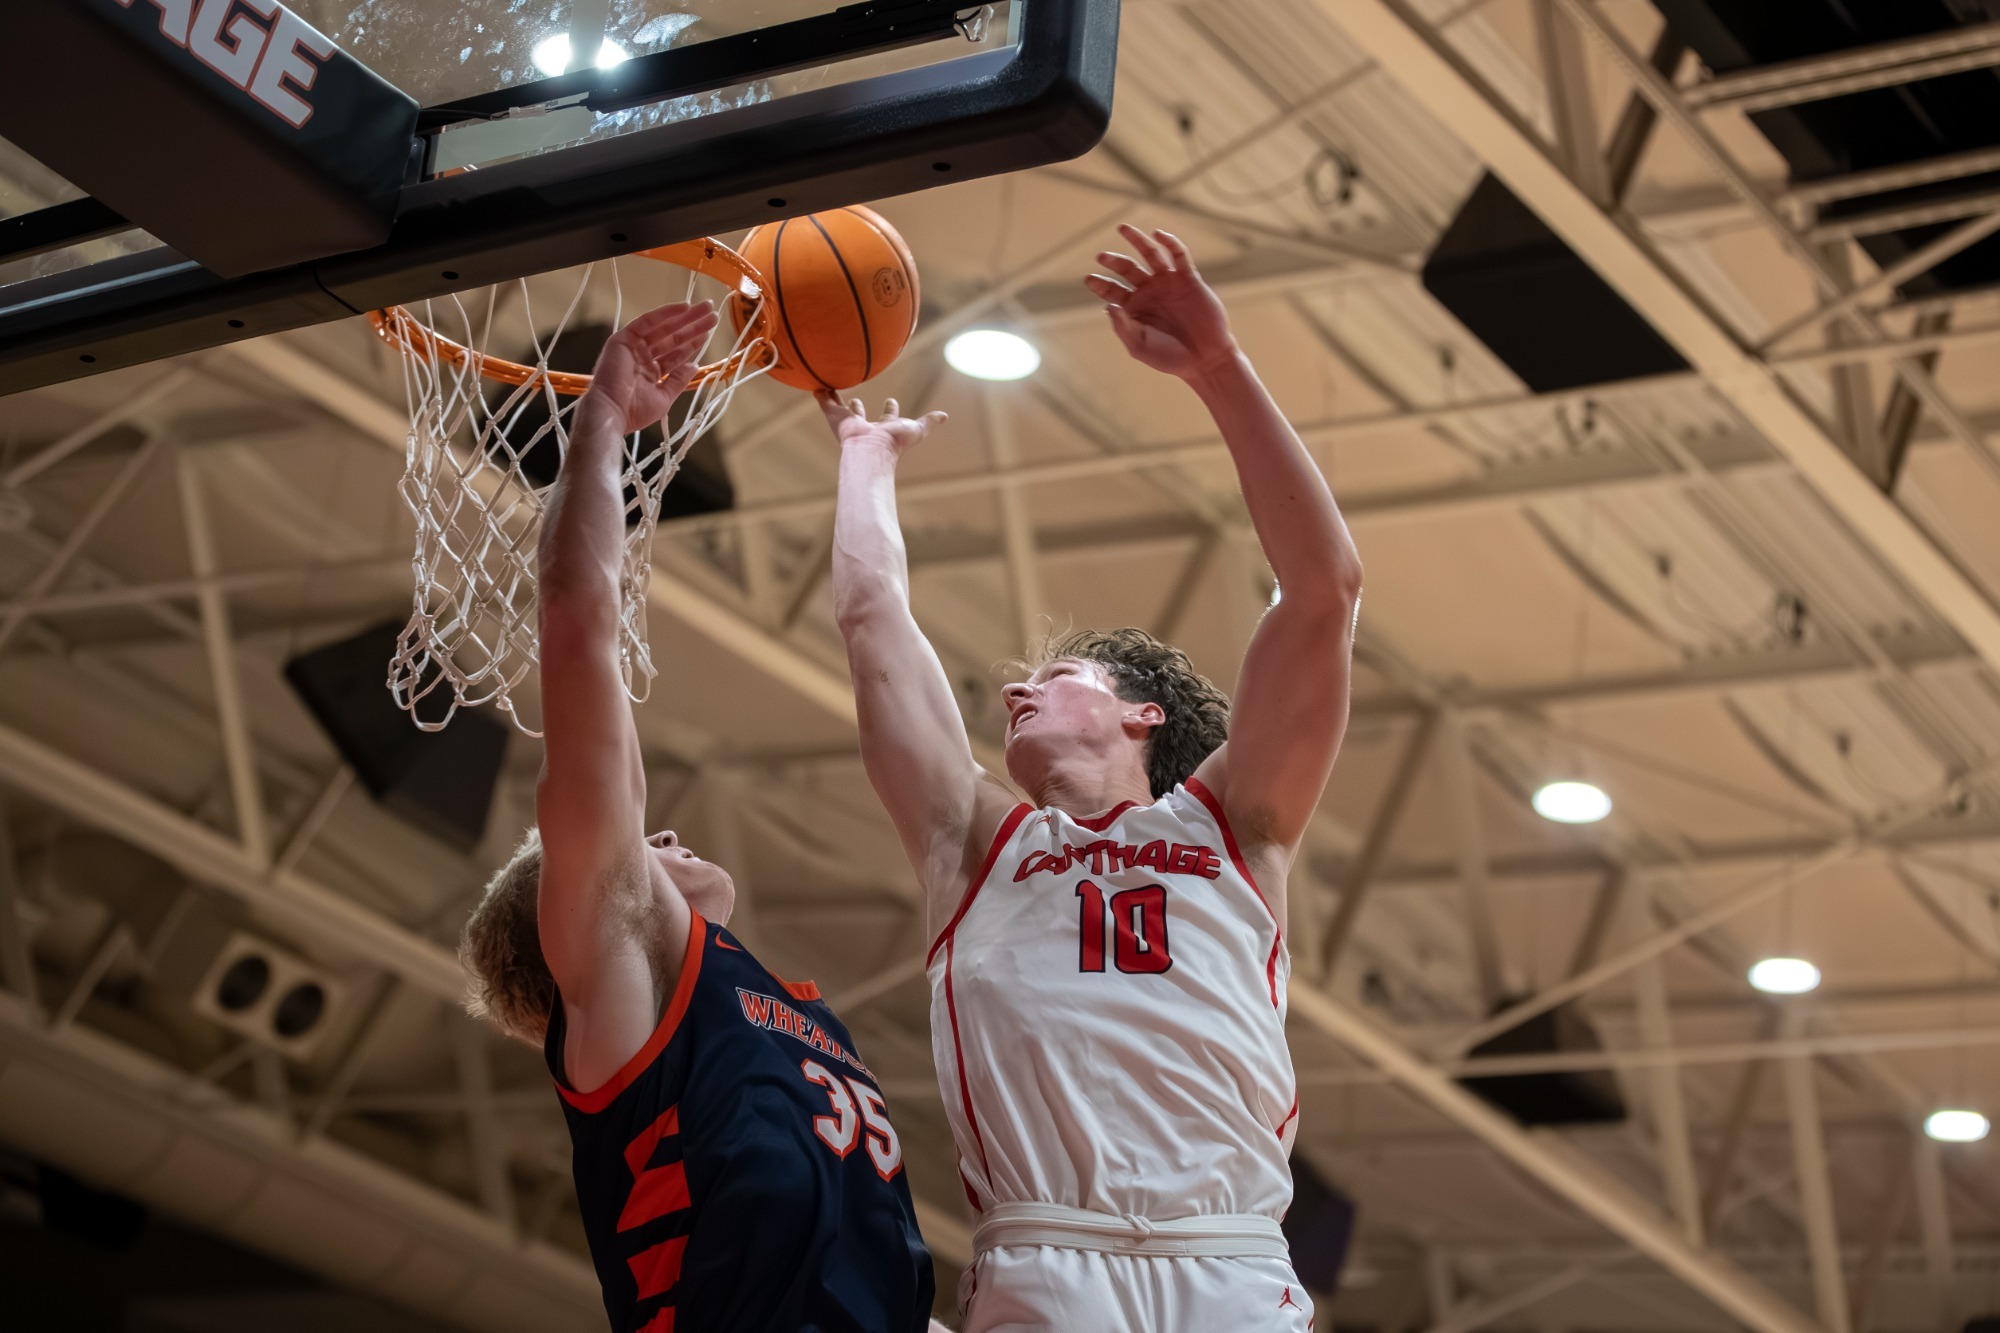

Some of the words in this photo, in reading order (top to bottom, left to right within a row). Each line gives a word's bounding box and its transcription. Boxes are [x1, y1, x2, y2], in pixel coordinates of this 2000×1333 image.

[1013, 839, 1222, 882] CARTHAGE
[1075, 879, 1173, 974] 10
[801, 1058, 904, 1182] 35
